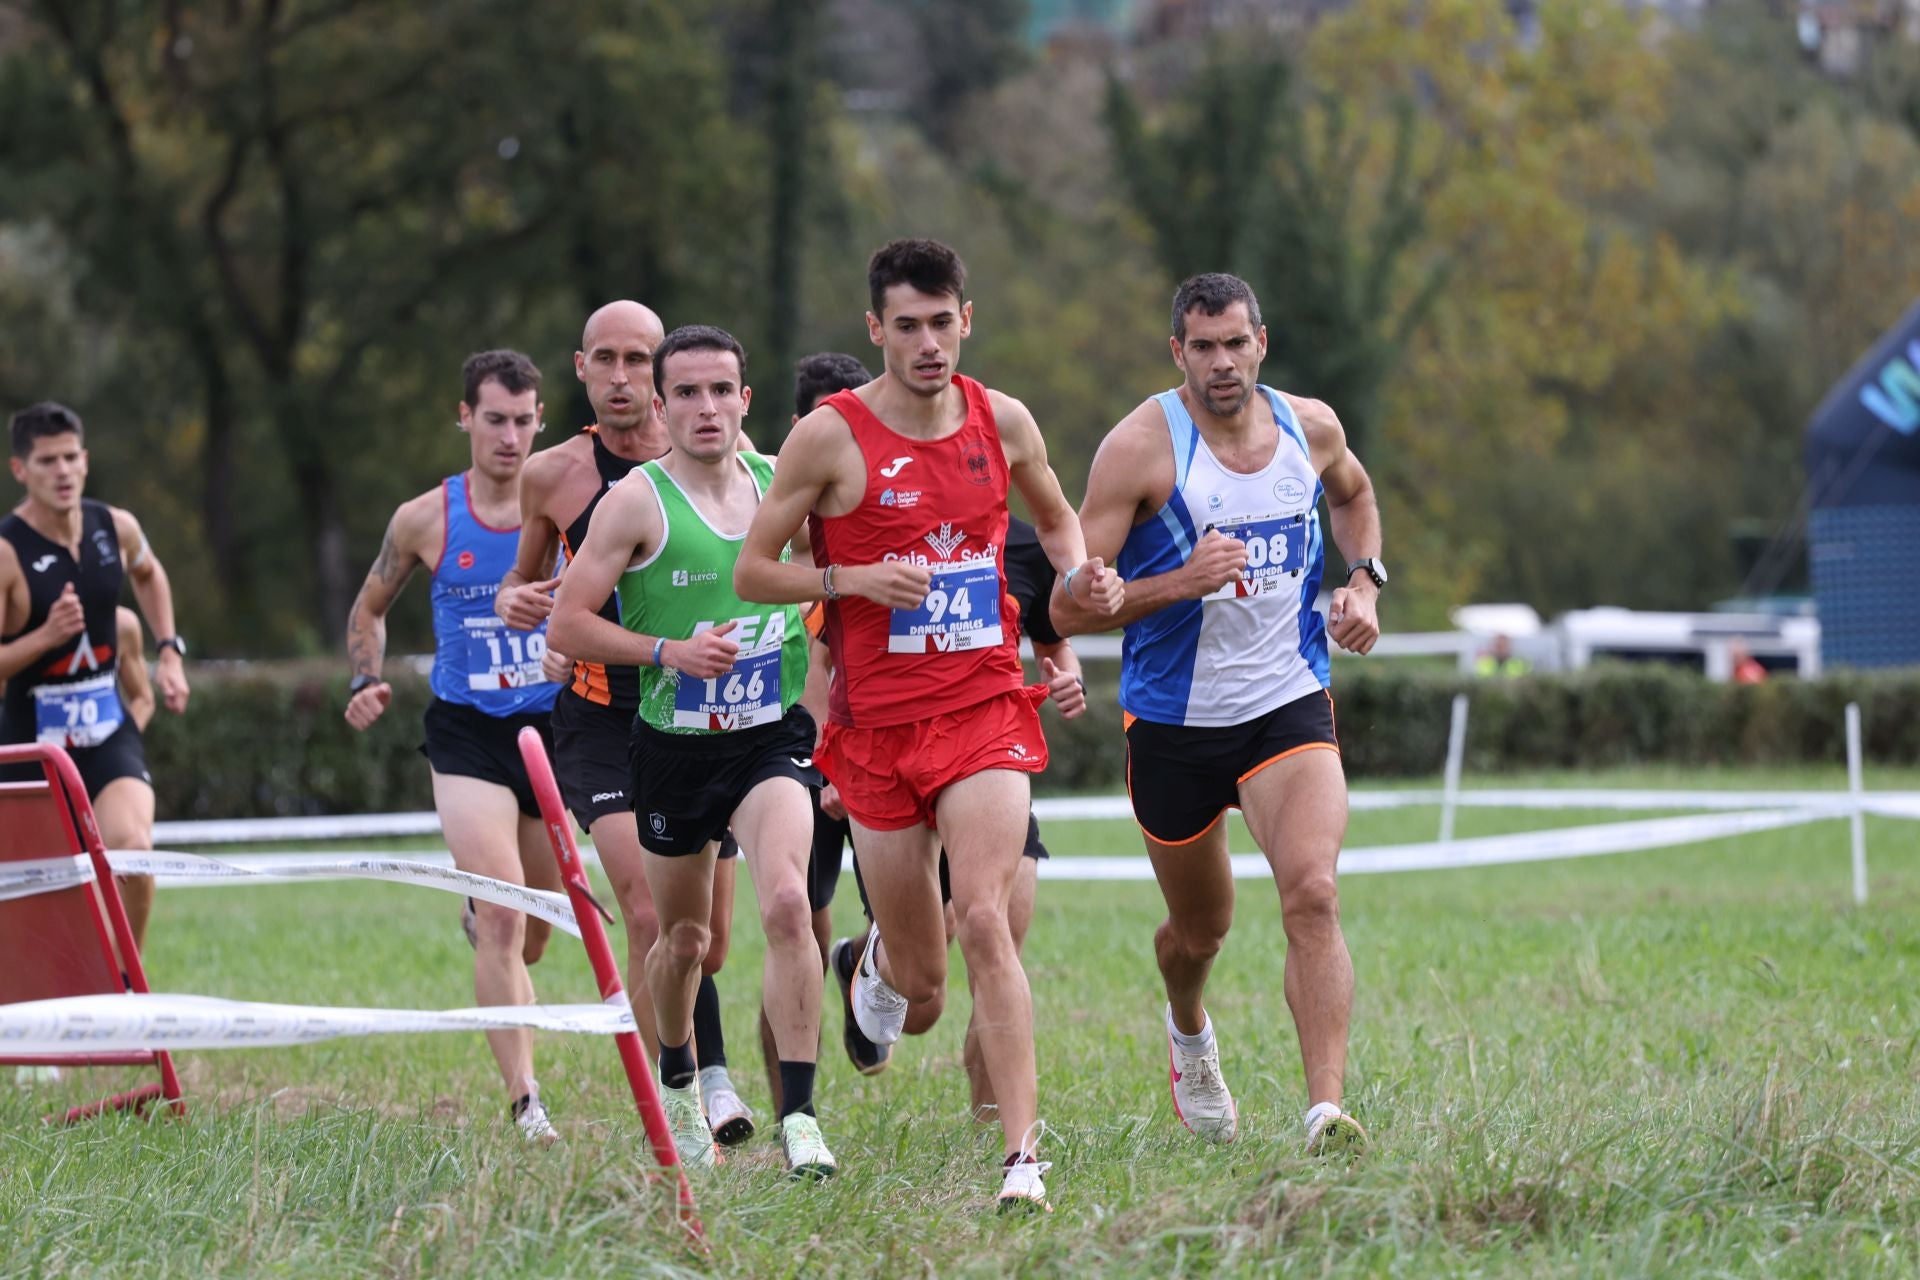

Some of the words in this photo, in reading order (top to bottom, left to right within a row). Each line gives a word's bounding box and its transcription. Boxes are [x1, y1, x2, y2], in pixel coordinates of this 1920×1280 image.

[1245, 533, 1288, 568] 08
[690, 573, 718, 581] ELEYCO
[925, 587, 972, 624] 94
[909, 623, 947, 636] DANIEL
[486, 633, 547, 665] 110
[703, 669, 765, 704] 166
[62, 699, 98, 727] 70
[699, 704, 726, 714] IBON
